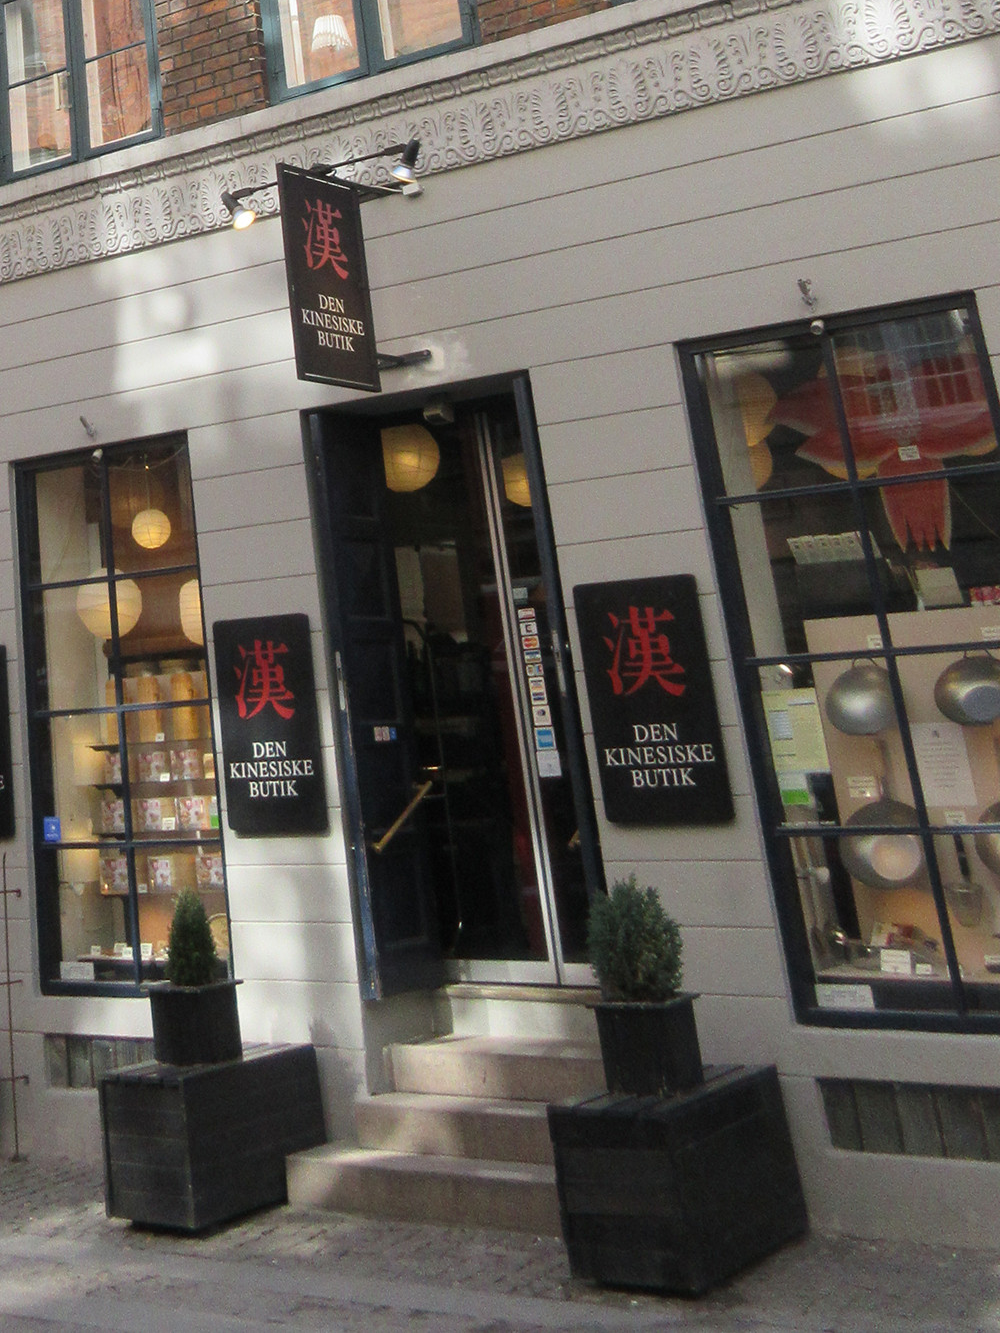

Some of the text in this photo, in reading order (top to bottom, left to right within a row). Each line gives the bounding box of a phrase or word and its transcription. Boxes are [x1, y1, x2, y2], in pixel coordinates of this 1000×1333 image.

[302, 198, 349, 280] 漢
[318, 294, 345, 314] DEN
[301, 308, 365, 336] KINESISKE
[317, 330, 355, 352] BUTIK
[602, 606, 686, 697] 漢
[233, 639, 295, 720] 漢
[632, 723, 678, 743] DEN
[252, 741, 287, 758] DEN
[604, 743, 716, 766] KINESISKE
[229, 760, 314, 779] KINESISKE
[630, 767, 697, 788] BUTIK
[249, 780, 299, 798] BUTIK
